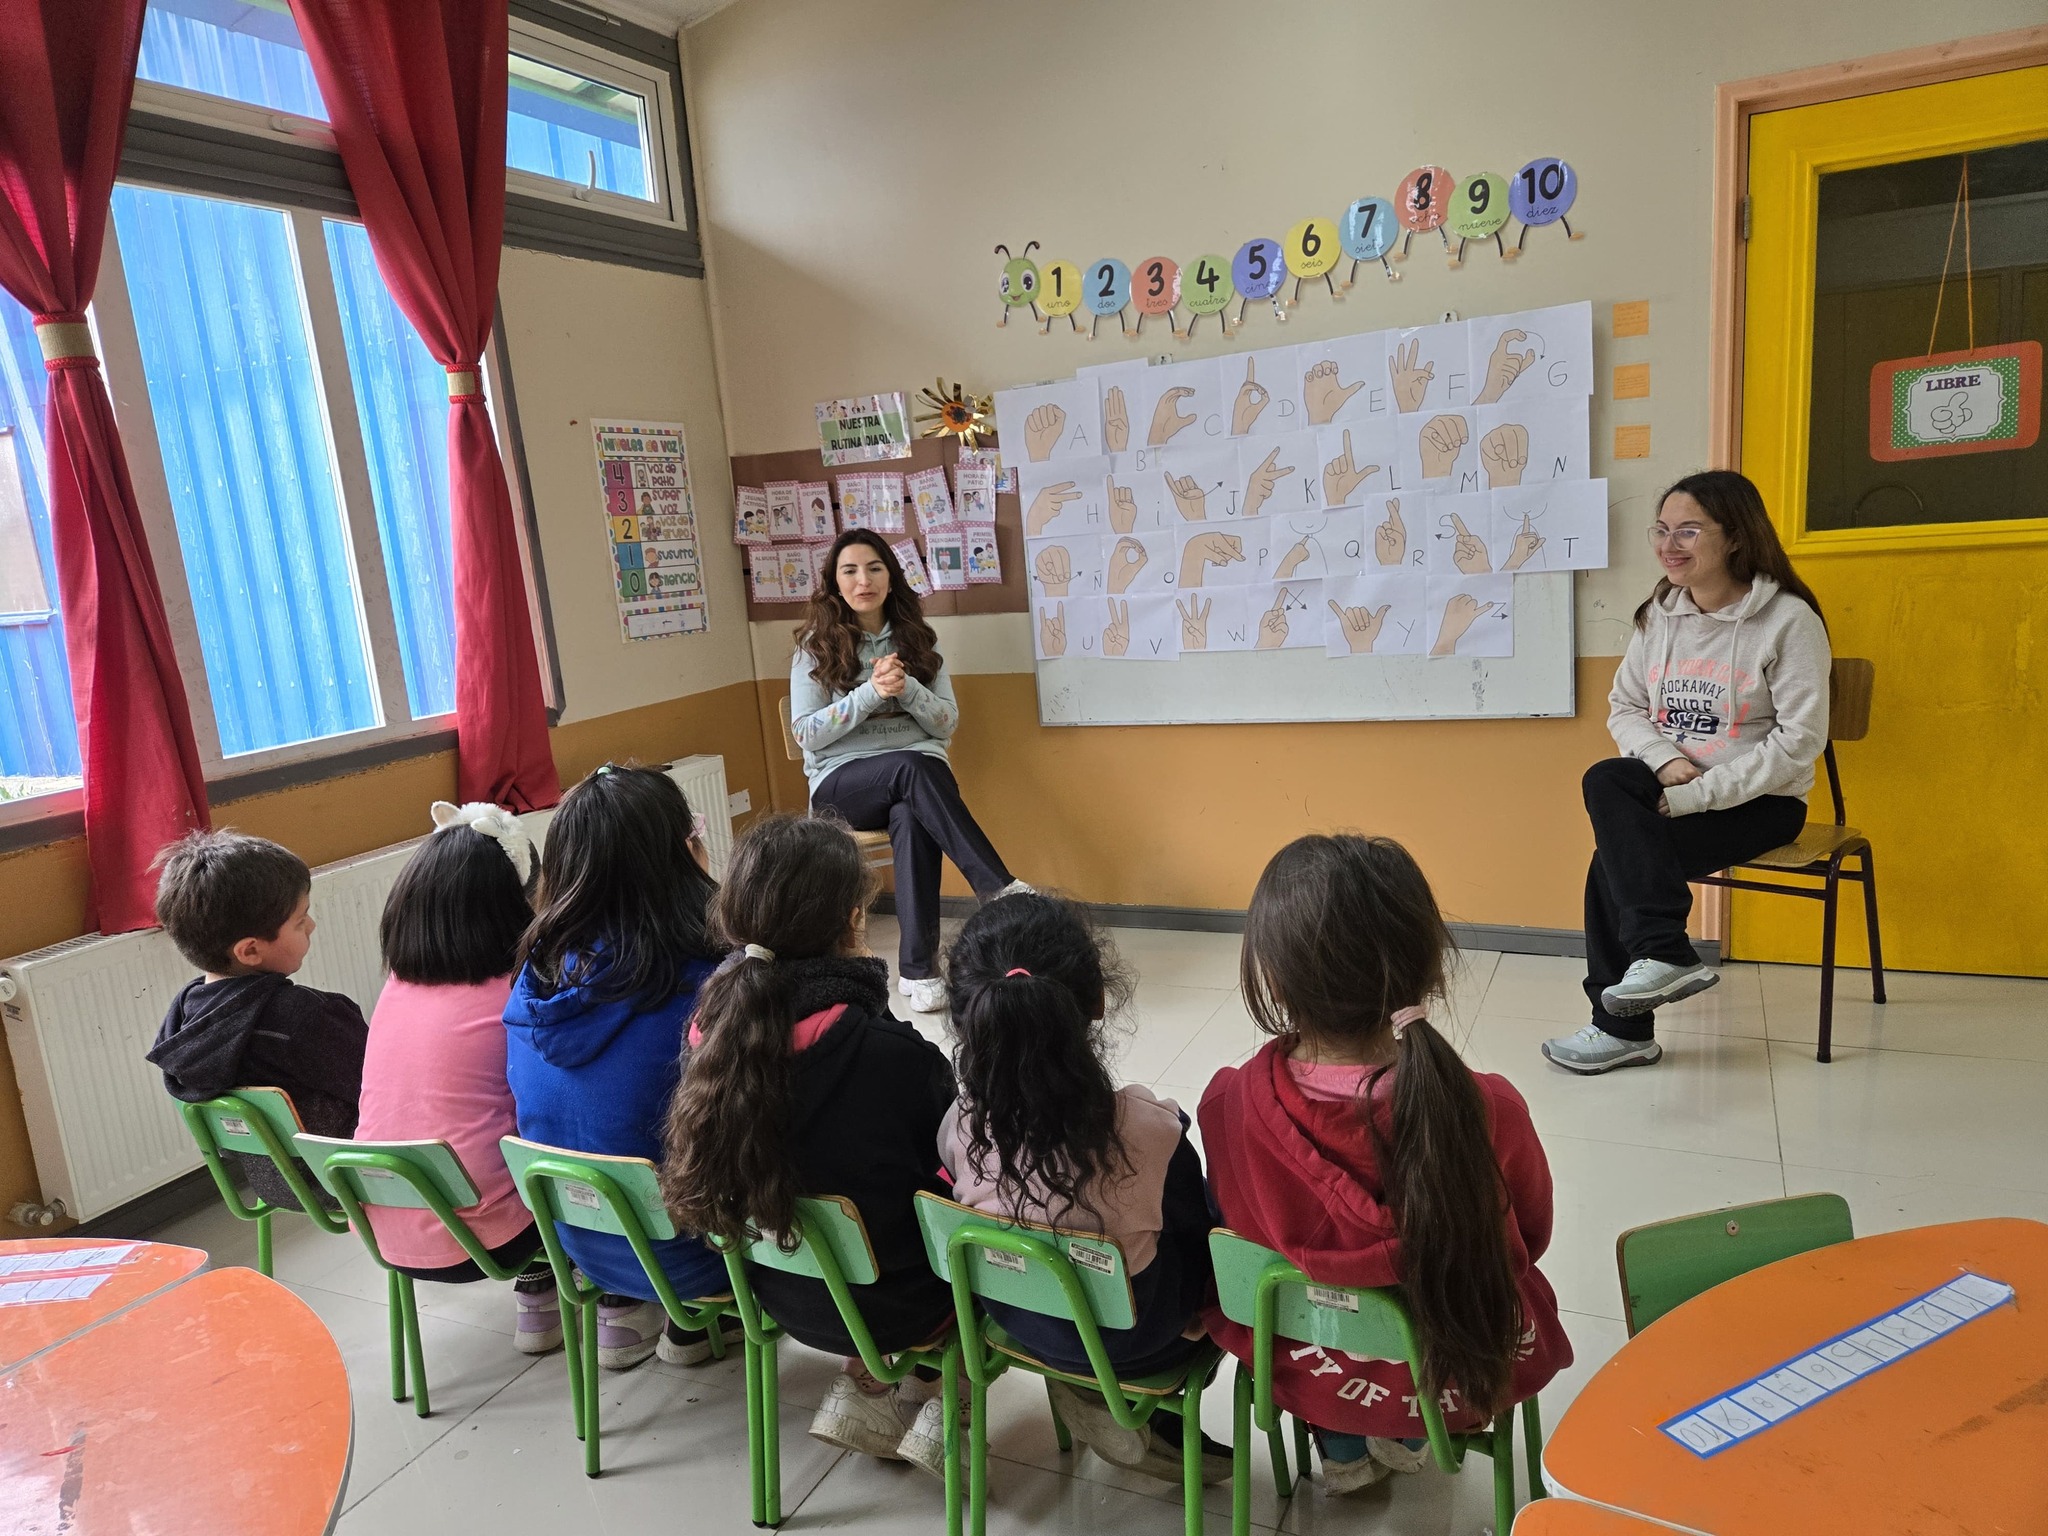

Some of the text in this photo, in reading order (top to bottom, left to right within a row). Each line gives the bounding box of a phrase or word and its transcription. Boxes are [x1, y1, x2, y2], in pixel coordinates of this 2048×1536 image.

[1413, 172, 1432, 210] 8
[1522, 164, 1565, 204] 10
[1468, 179, 1490, 214] 9
[1358, 203, 1377, 238] 7
[1526, 205, 1559, 218] diez
[1458, 218, 1503, 232] nueve
[1301, 223, 1321, 257] 6
[1248, 244, 1267, 280] 5
[1300, 260, 1323, 270] seis
[1051, 267, 1061, 297] 1
[1098, 264, 1115, 298] 2
[1147, 262, 1165, 297] 3
[1196, 260, 1220, 293] 4
[1045, 300, 1071, 309] uno
[1097, 299, 1116, 309] dos
[1146, 298, 1168, 309] tres
[1189, 296, 1227, 307] cuatro
[1548, 361, 1567, 386] G
[1926, 374, 1981, 392] LIBRE
[1449, 374, 1465, 399] F
[1277, 399, 1295, 417] D
[1370, 388, 1385, 412] E
[839, 415, 880, 430] NUESTRA
[1204, 414, 1222, 436] C
[831, 437, 862, 450] RUTINA
[1069, 424, 1088, 450] A
[1136, 450, 1147, 472] B
[1553, 456, 1567, 479] N
[613, 464, 625, 484] 4
[1389, 466, 1401, 490] L
[1460, 471, 1478, 493] M
[1304, 478, 1316, 503] K
[618, 491, 628, 512] 3
[1226, 491, 1239, 515] J
[1086, 503, 1099, 524] H
[622, 519, 632, 539] 2
[1258, 548, 1268, 566] P
[1344, 540, 1360, 559] Q
[1563, 537, 1579, 558] T
[1412, 550, 1424, 567] R
[630, 573, 640, 592] 0
[1093, 570, 1102, 590] Ñ
[1163, 571, 1175, 583] O
[1082, 635, 1094, 650] U
[1227, 624, 1245, 642] W
[1397, 619, 1415, 647] Y
[1150, 638, 1162, 654] V
[1660, 679, 1726, 699] ROCKAWAY
[1912, 1305, 1947, 1326] 2
[1882, 1320, 1930, 1341] 3
[1831, 1343, 1879, 1370] 5
[1848, 1337, 1900, 1358] 4
[1811, 1364, 1836, 1380] 6
[1337, 1378, 1391, 1408] OF
[1752, 1396, 1774, 1408] 8
[1719, 1403, 1749, 1431] 9
[1680, 1422, 1720, 1448] 10
